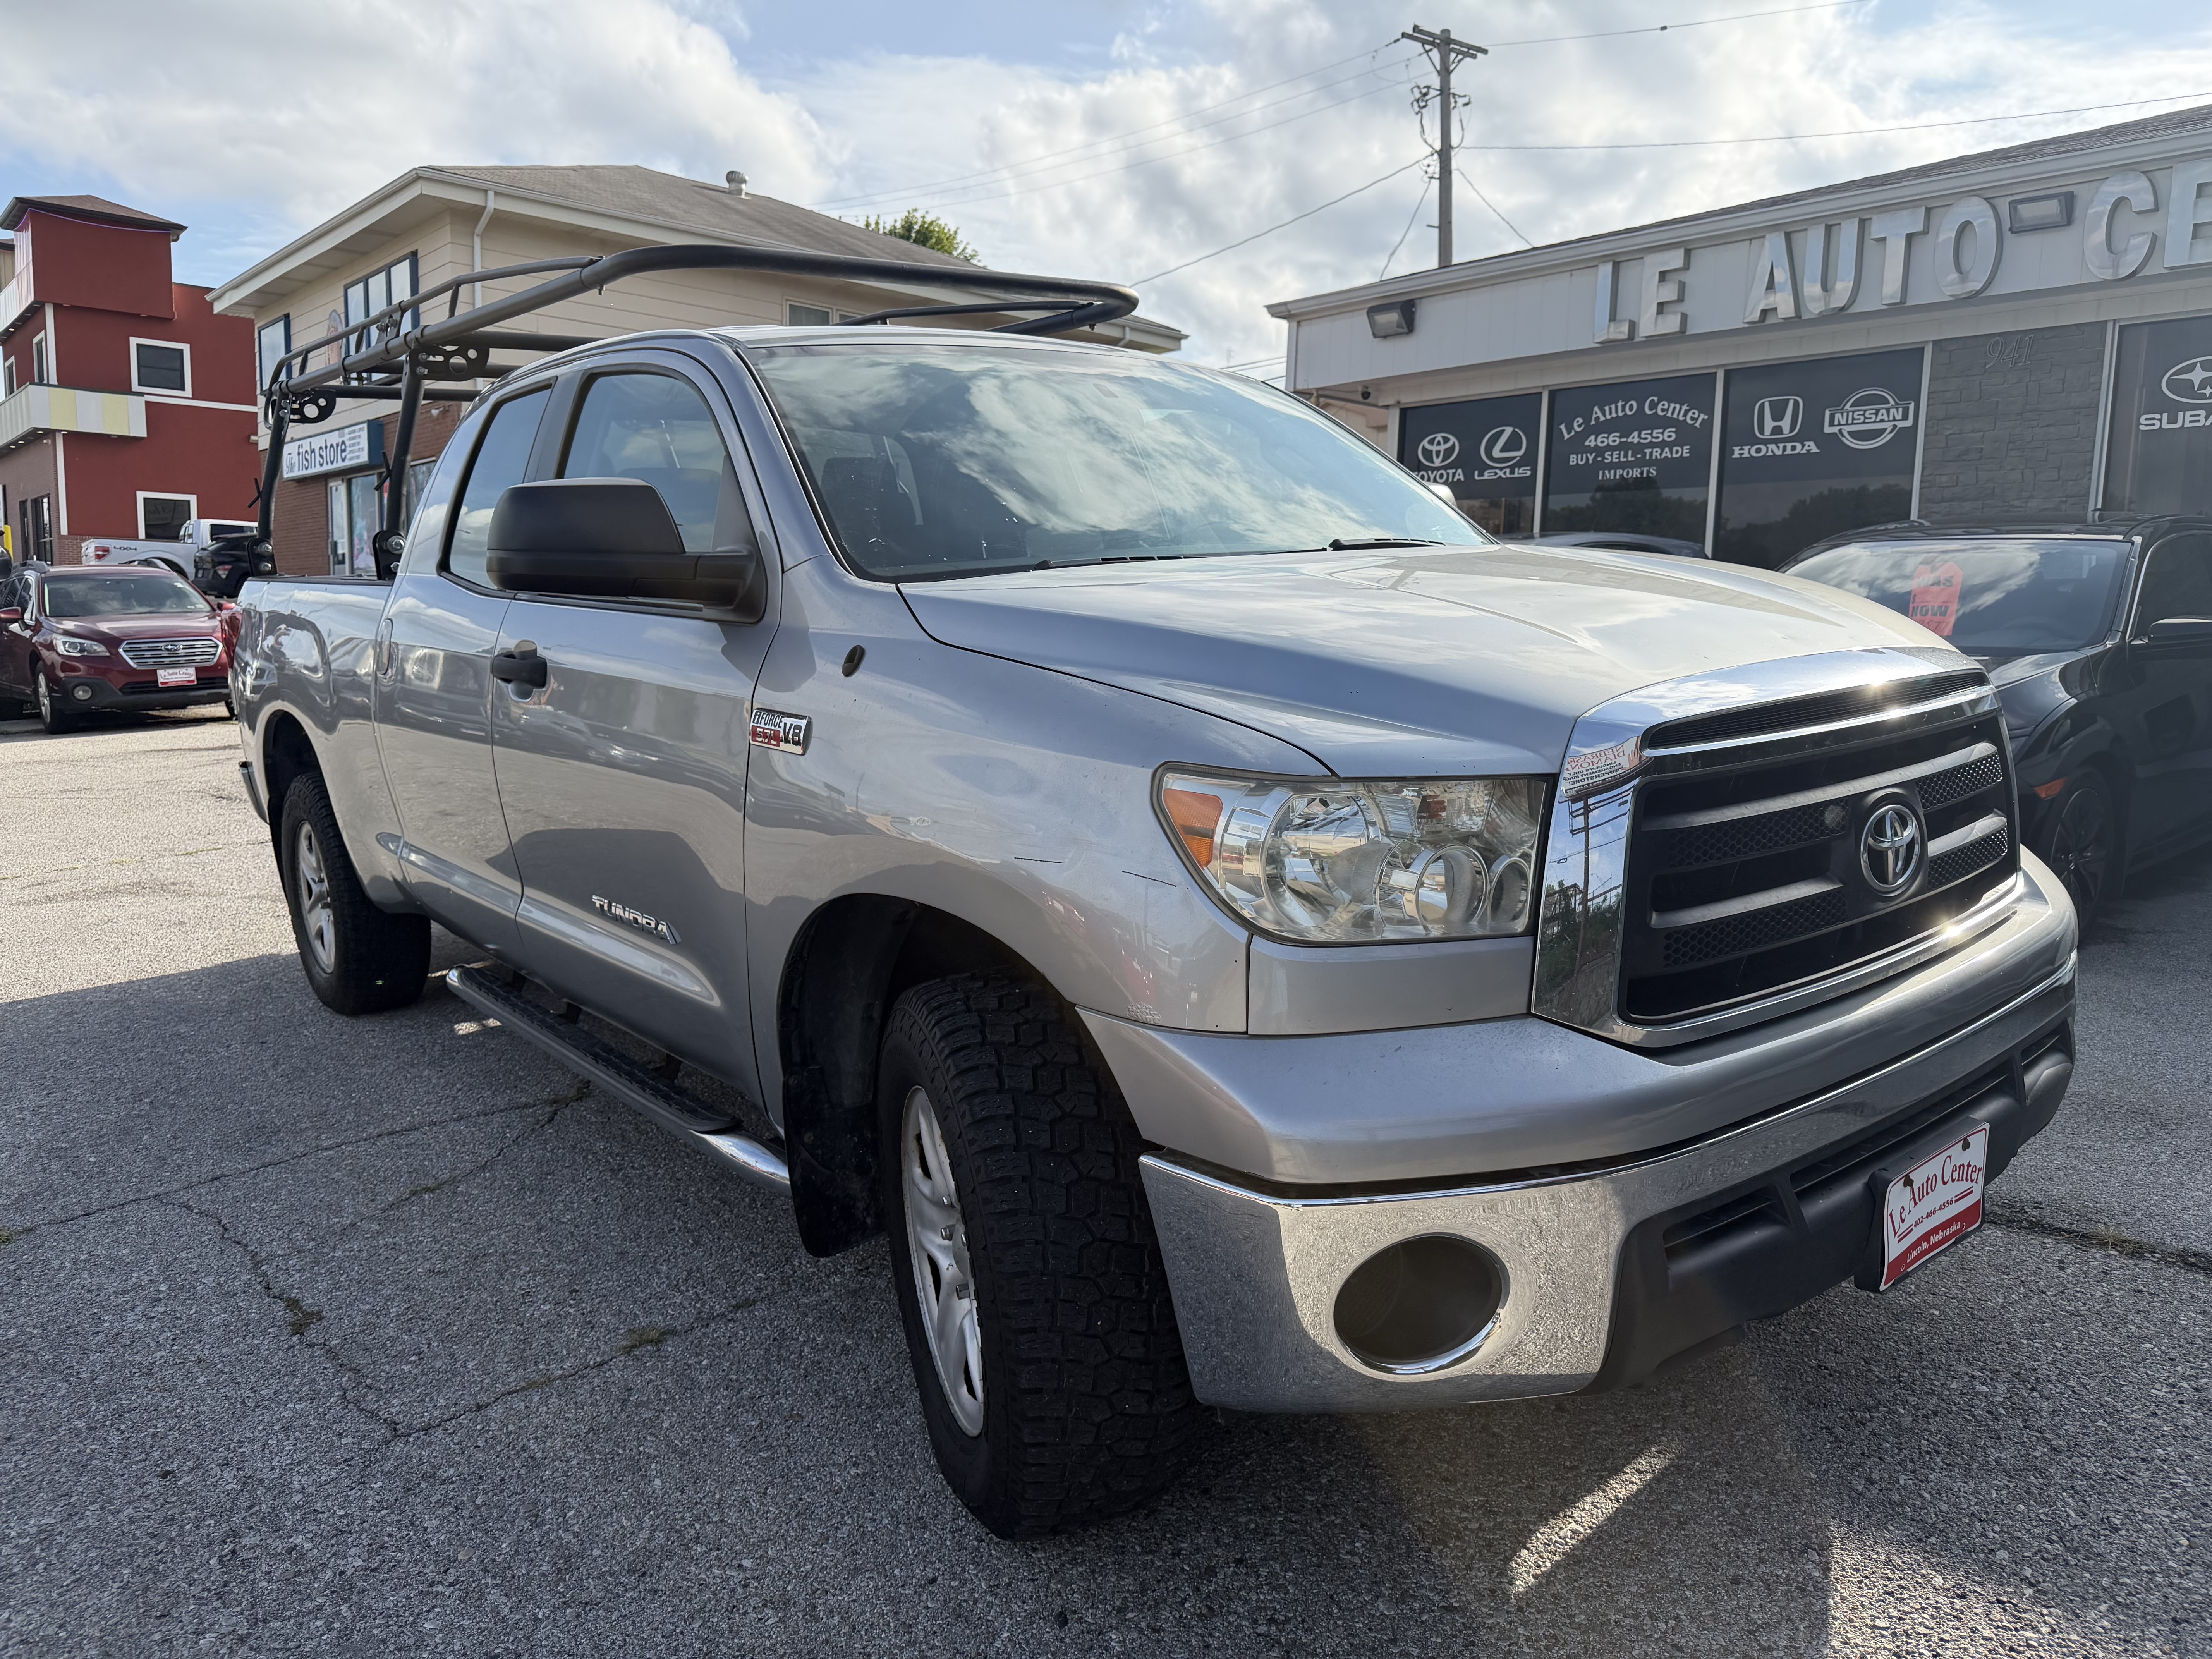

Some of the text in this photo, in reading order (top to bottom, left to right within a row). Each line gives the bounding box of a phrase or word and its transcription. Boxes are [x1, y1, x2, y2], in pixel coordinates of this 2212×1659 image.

[1593, 248, 1690, 343] LE
[1743, 196, 2002, 323] AUTO
[1985, 334, 2034, 368] 941
[1559, 396, 1708, 440] Le Auto Center
[1834, 408, 1903, 425] NISSAN
[2139, 410, 2212, 430] SUB
[1585, 428, 1676, 447] 466-4556
[1732, 441, 1820, 458] HONDA
[297, 439, 347, 472] fish store
[1474, 467, 1531, 480] LEXUS
[1599, 467, 1657, 480] IMPORTS
[1917, 576, 1954, 587] WAS
[1911, 605, 1949, 617] NOW
[783, 722, 802, 746] V8
[592, 895, 680, 944] TUNDRA
[1889, 1154, 1982, 1239] Le Auto Center
[1913, 1197, 1954, 1228] 402-466-4556
[1907, 1221, 1961, 1263] Lincoln, Nebraska
